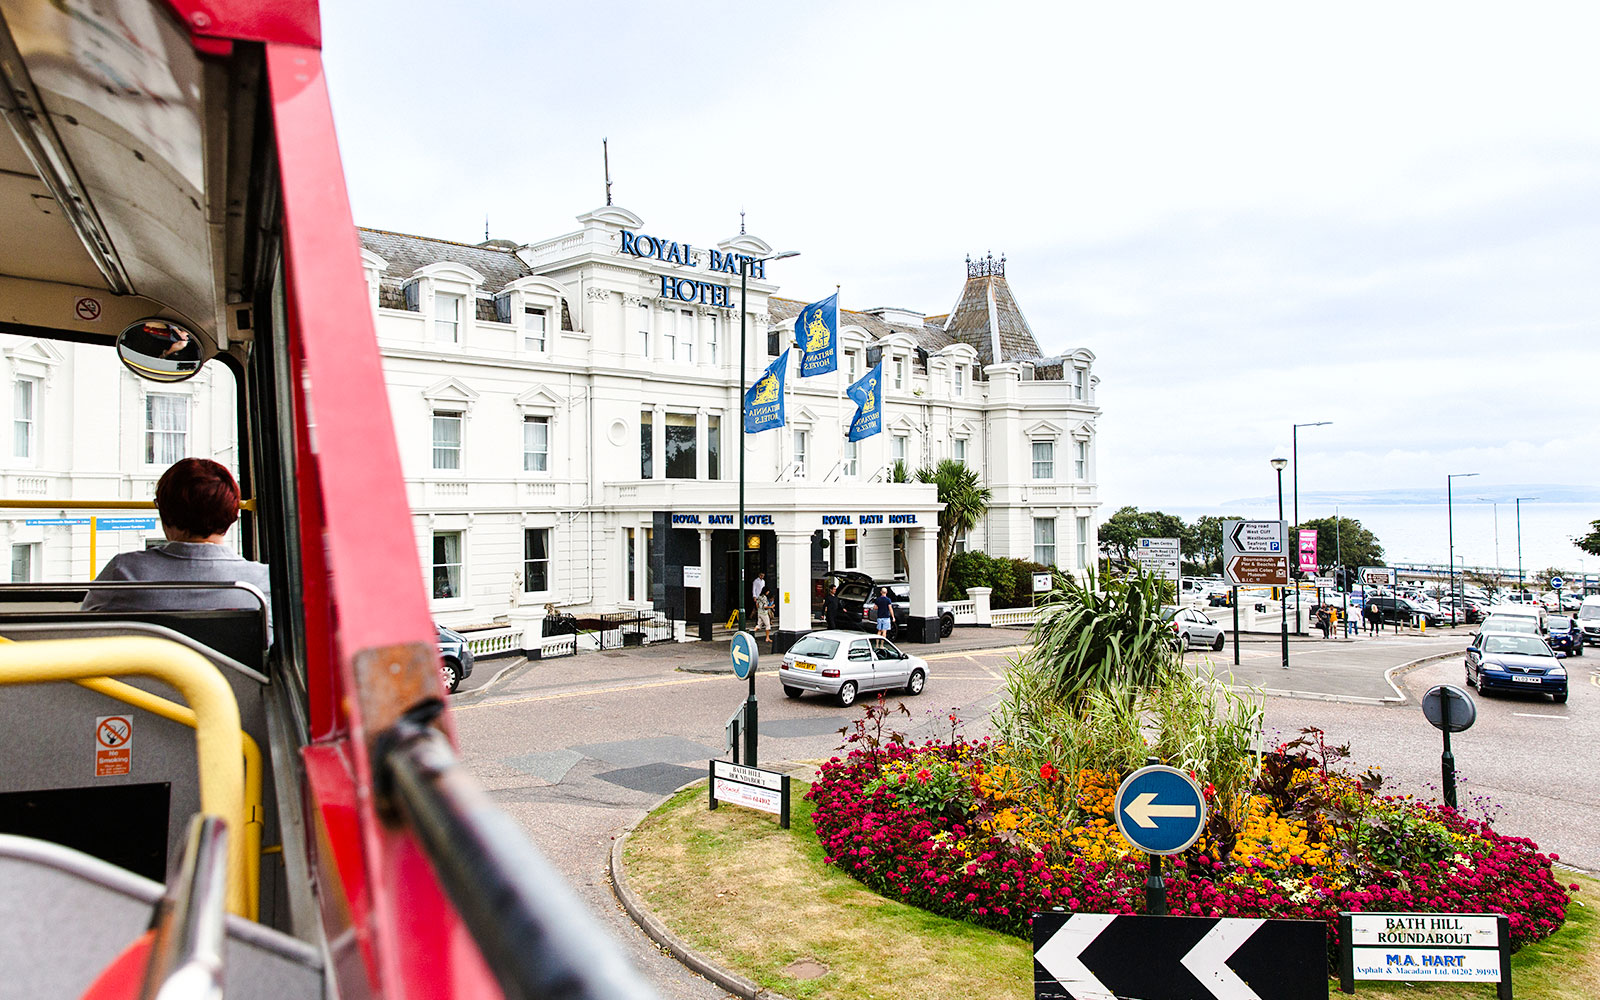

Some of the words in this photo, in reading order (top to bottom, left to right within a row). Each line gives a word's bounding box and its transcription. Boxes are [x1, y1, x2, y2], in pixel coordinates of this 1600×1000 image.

[620, 230, 697, 267] ROYAL
[709, 249, 766, 280] BATH
[660, 275, 735, 308] HOTEL
[672, 515, 701, 524] ROYAL
[708, 515, 734, 525] BATH
[822, 515, 853, 525] ROYAL
[859, 515, 883, 525] BATH
[889, 514, 918, 524] HOTEL
[729, 772, 766, 785] ROUNDABOUT
[733, 767, 747, 775] BATH
[748, 769, 762, 778] HILL
[1385, 918, 1425, 930] BATH
[1431, 919, 1463, 930] HILL
[1377, 932, 1472, 944] ROUNDABOUT
[1386, 954, 1419, 966] M.A.
[1422, 954, 1466, 967] HART
[1356, 966, 1383, 974] Asphalt
